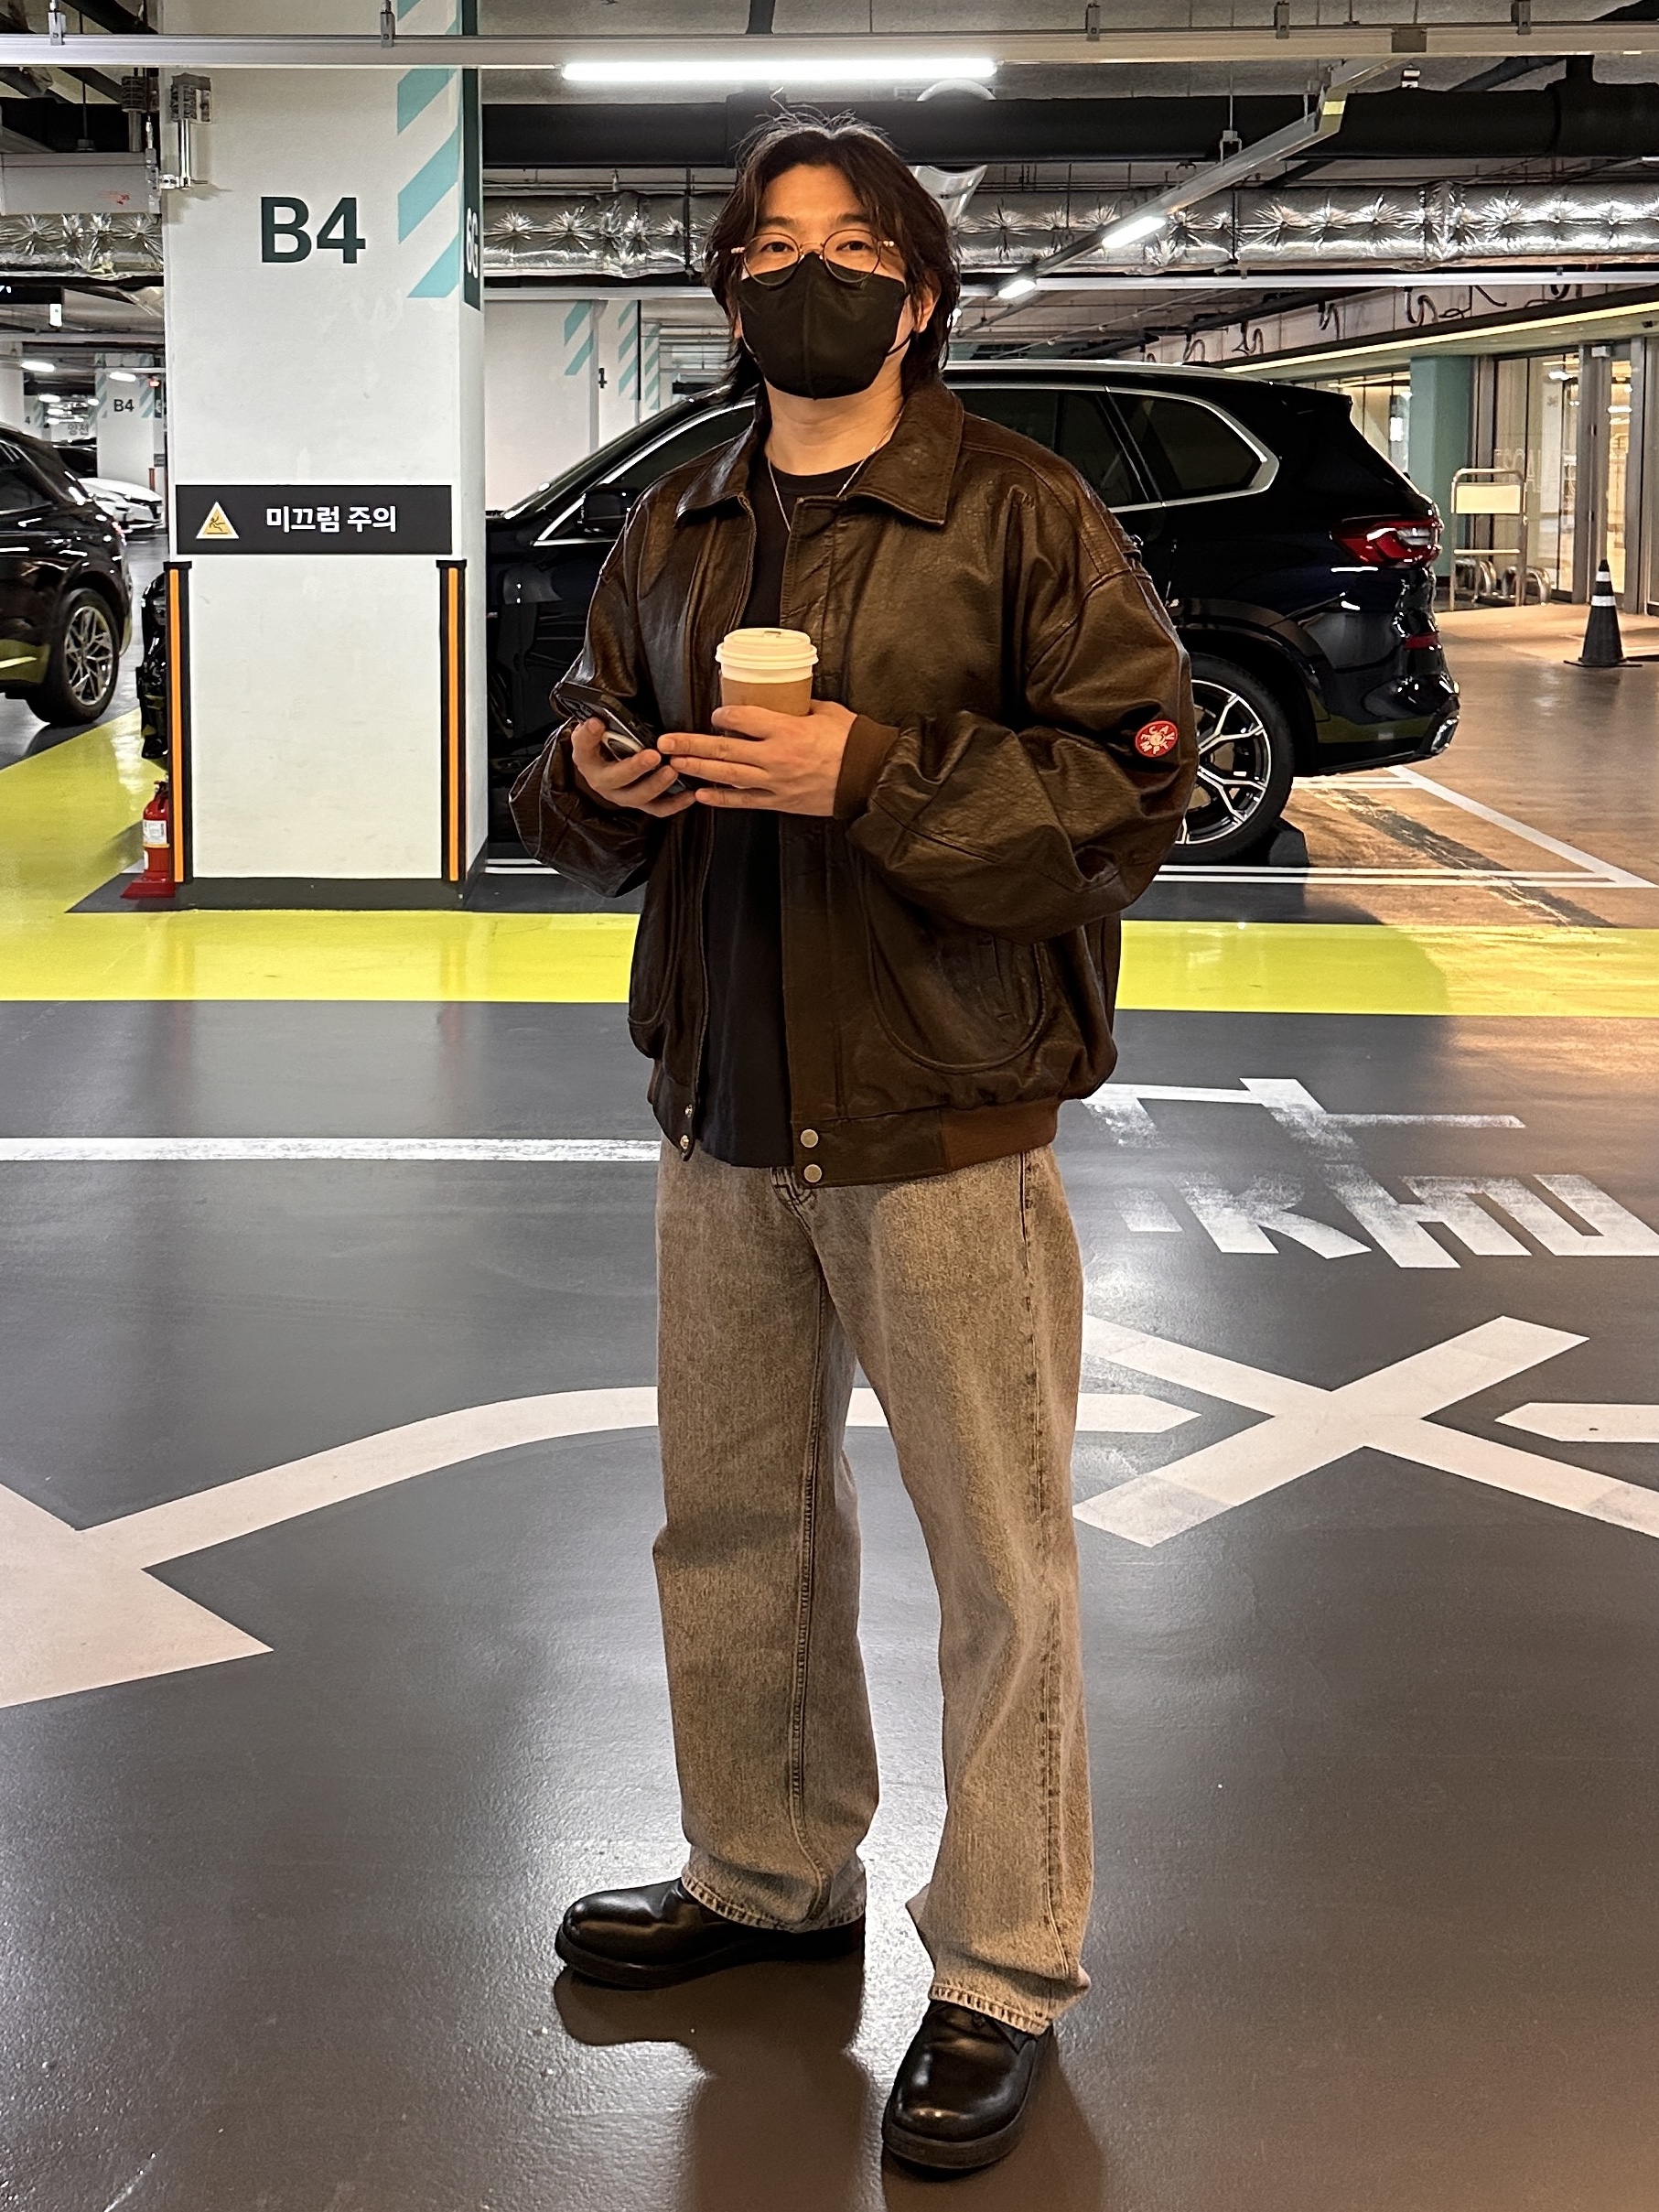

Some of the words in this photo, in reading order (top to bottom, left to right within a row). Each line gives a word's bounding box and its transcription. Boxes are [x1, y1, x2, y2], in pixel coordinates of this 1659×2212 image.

[261, 197, 366, 264] B4
[113, 399, 135, 412] B4
[266, 505, 340, 533] 미끄럼
[347, 505, 396, 533] 주의
